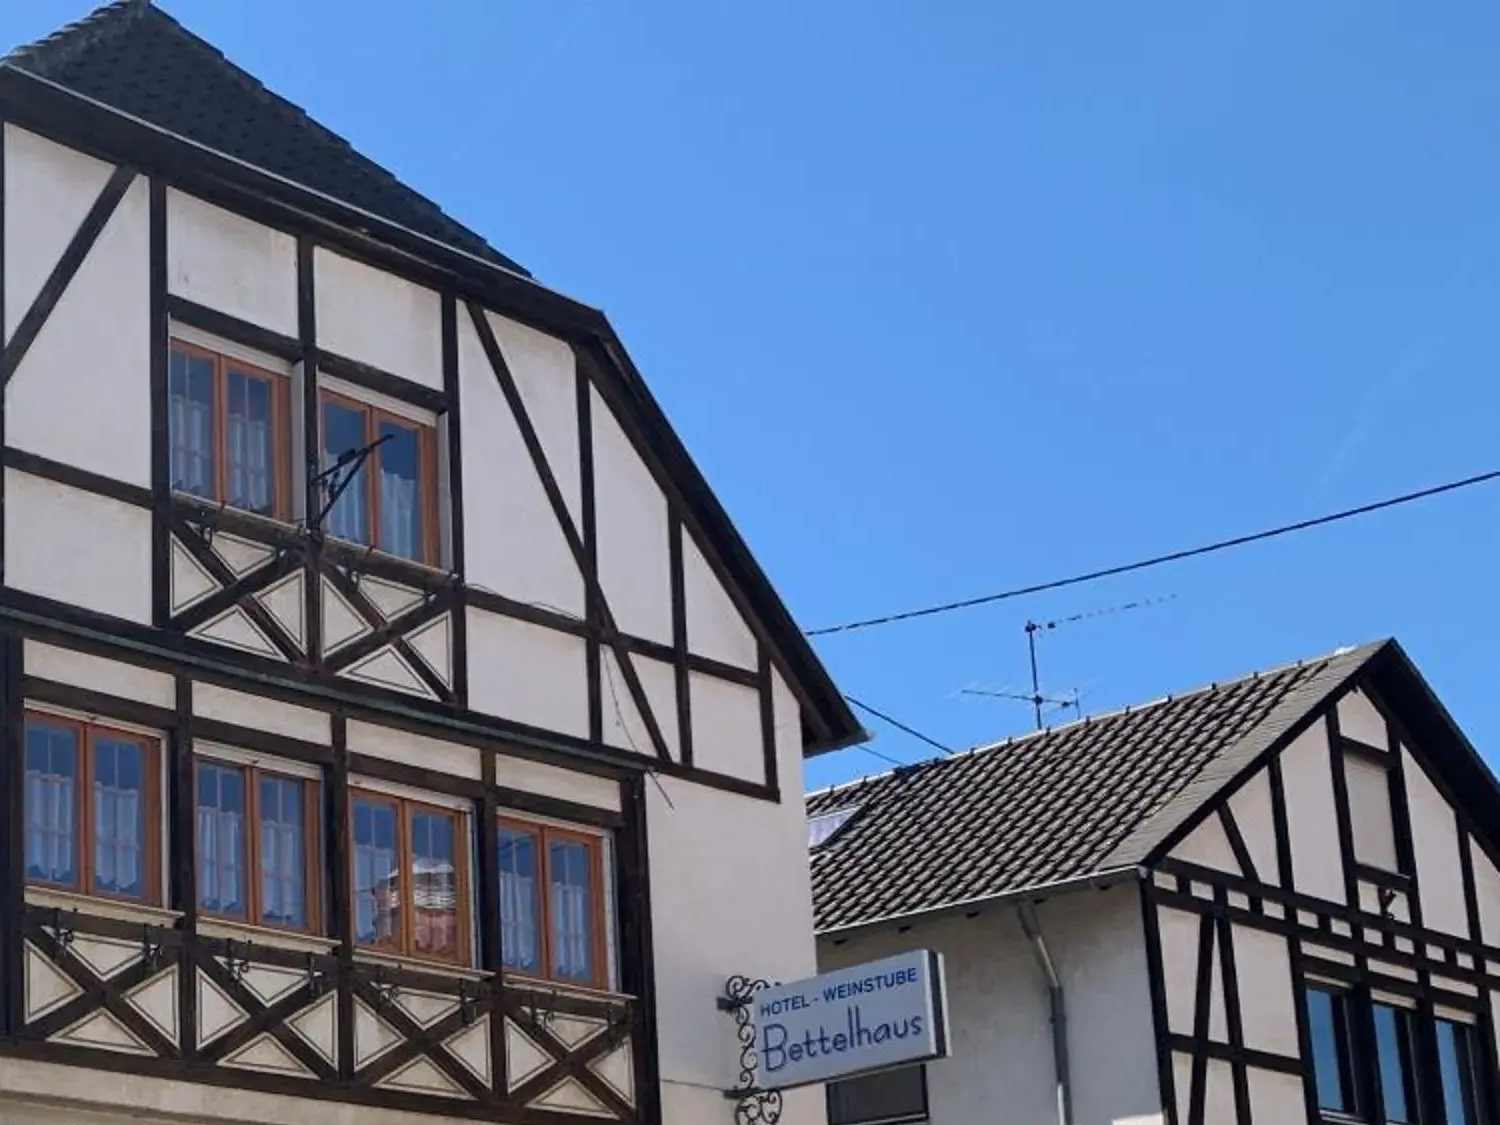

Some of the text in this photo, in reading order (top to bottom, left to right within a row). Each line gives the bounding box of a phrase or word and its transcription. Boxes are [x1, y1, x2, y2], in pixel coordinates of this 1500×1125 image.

[760, 994, 810, 1017] HOTEL
[823, 967, 917, 1002] WEINSTUBE
[762, 1004, 923, 1072] Bettelhaus
